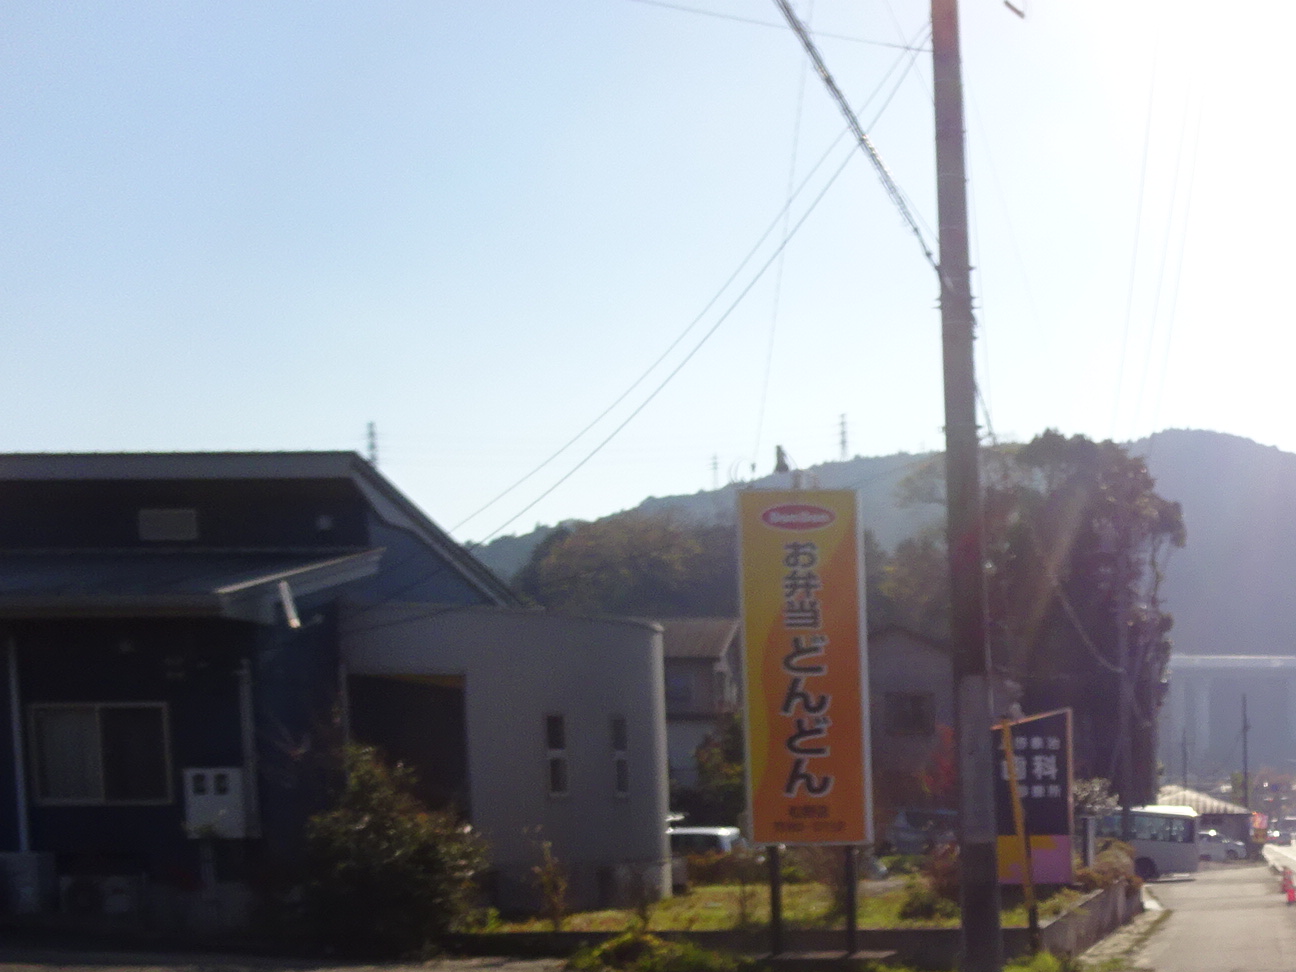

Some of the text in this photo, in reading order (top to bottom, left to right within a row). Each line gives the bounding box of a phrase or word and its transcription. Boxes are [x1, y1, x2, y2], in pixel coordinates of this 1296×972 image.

[781, 542, 834, 798] お弁当どんどん
